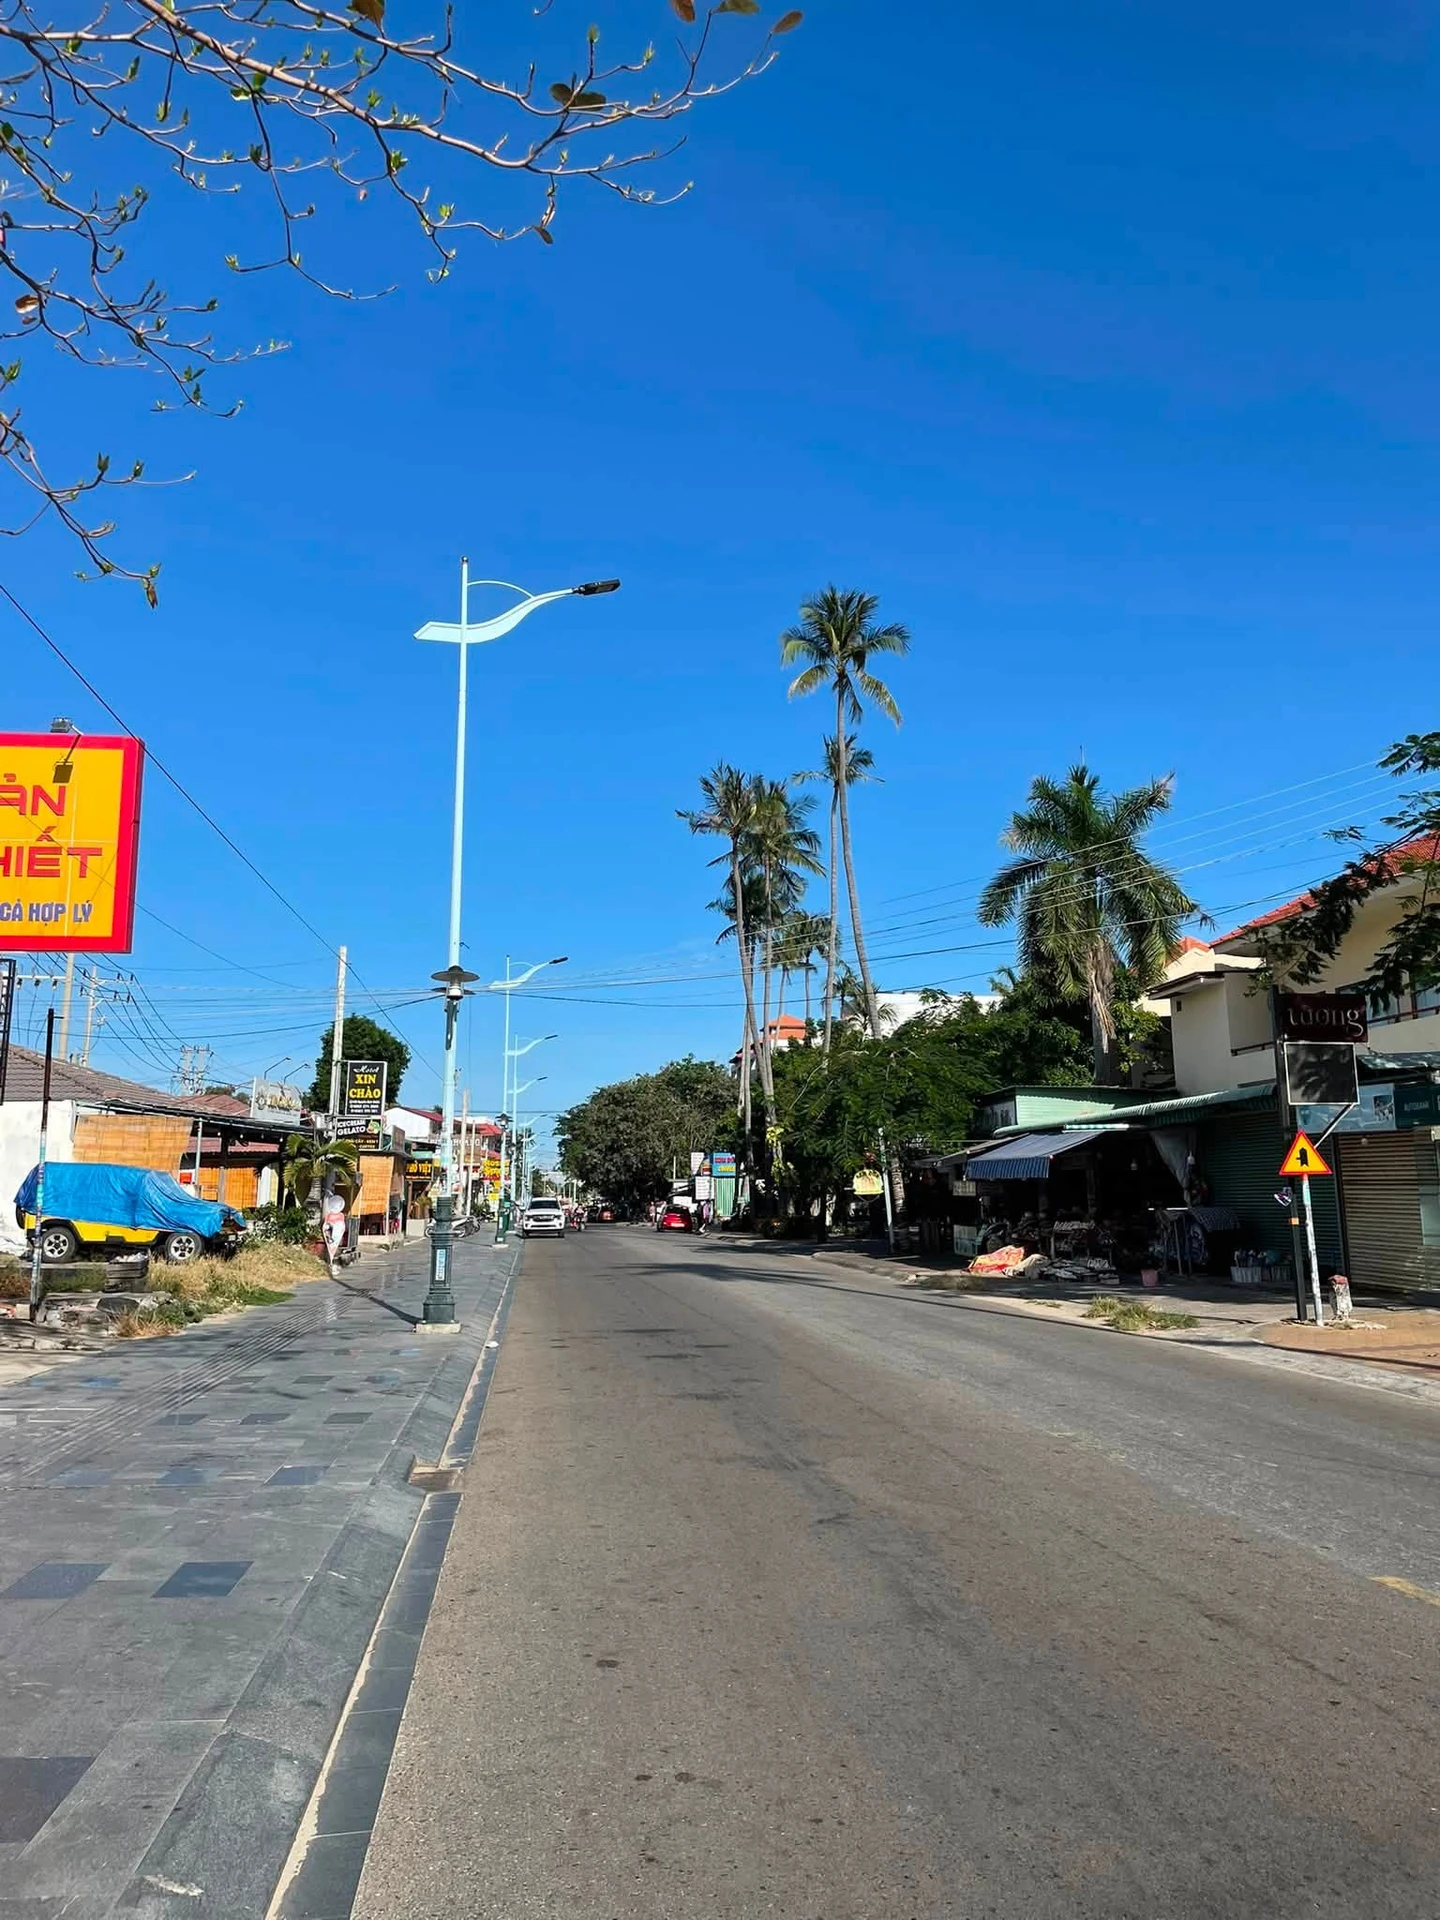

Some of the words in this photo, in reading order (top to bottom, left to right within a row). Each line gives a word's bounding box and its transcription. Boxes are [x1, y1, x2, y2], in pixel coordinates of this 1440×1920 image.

[28, 899, 66, 926] HỢP
[72, 898, 94, 922] LÝ
[355, 1074, 377, 1084] XIN
[349, 1086, 381, 1099] CHÀO
[337, 1126, 366, 1136] GELATO
